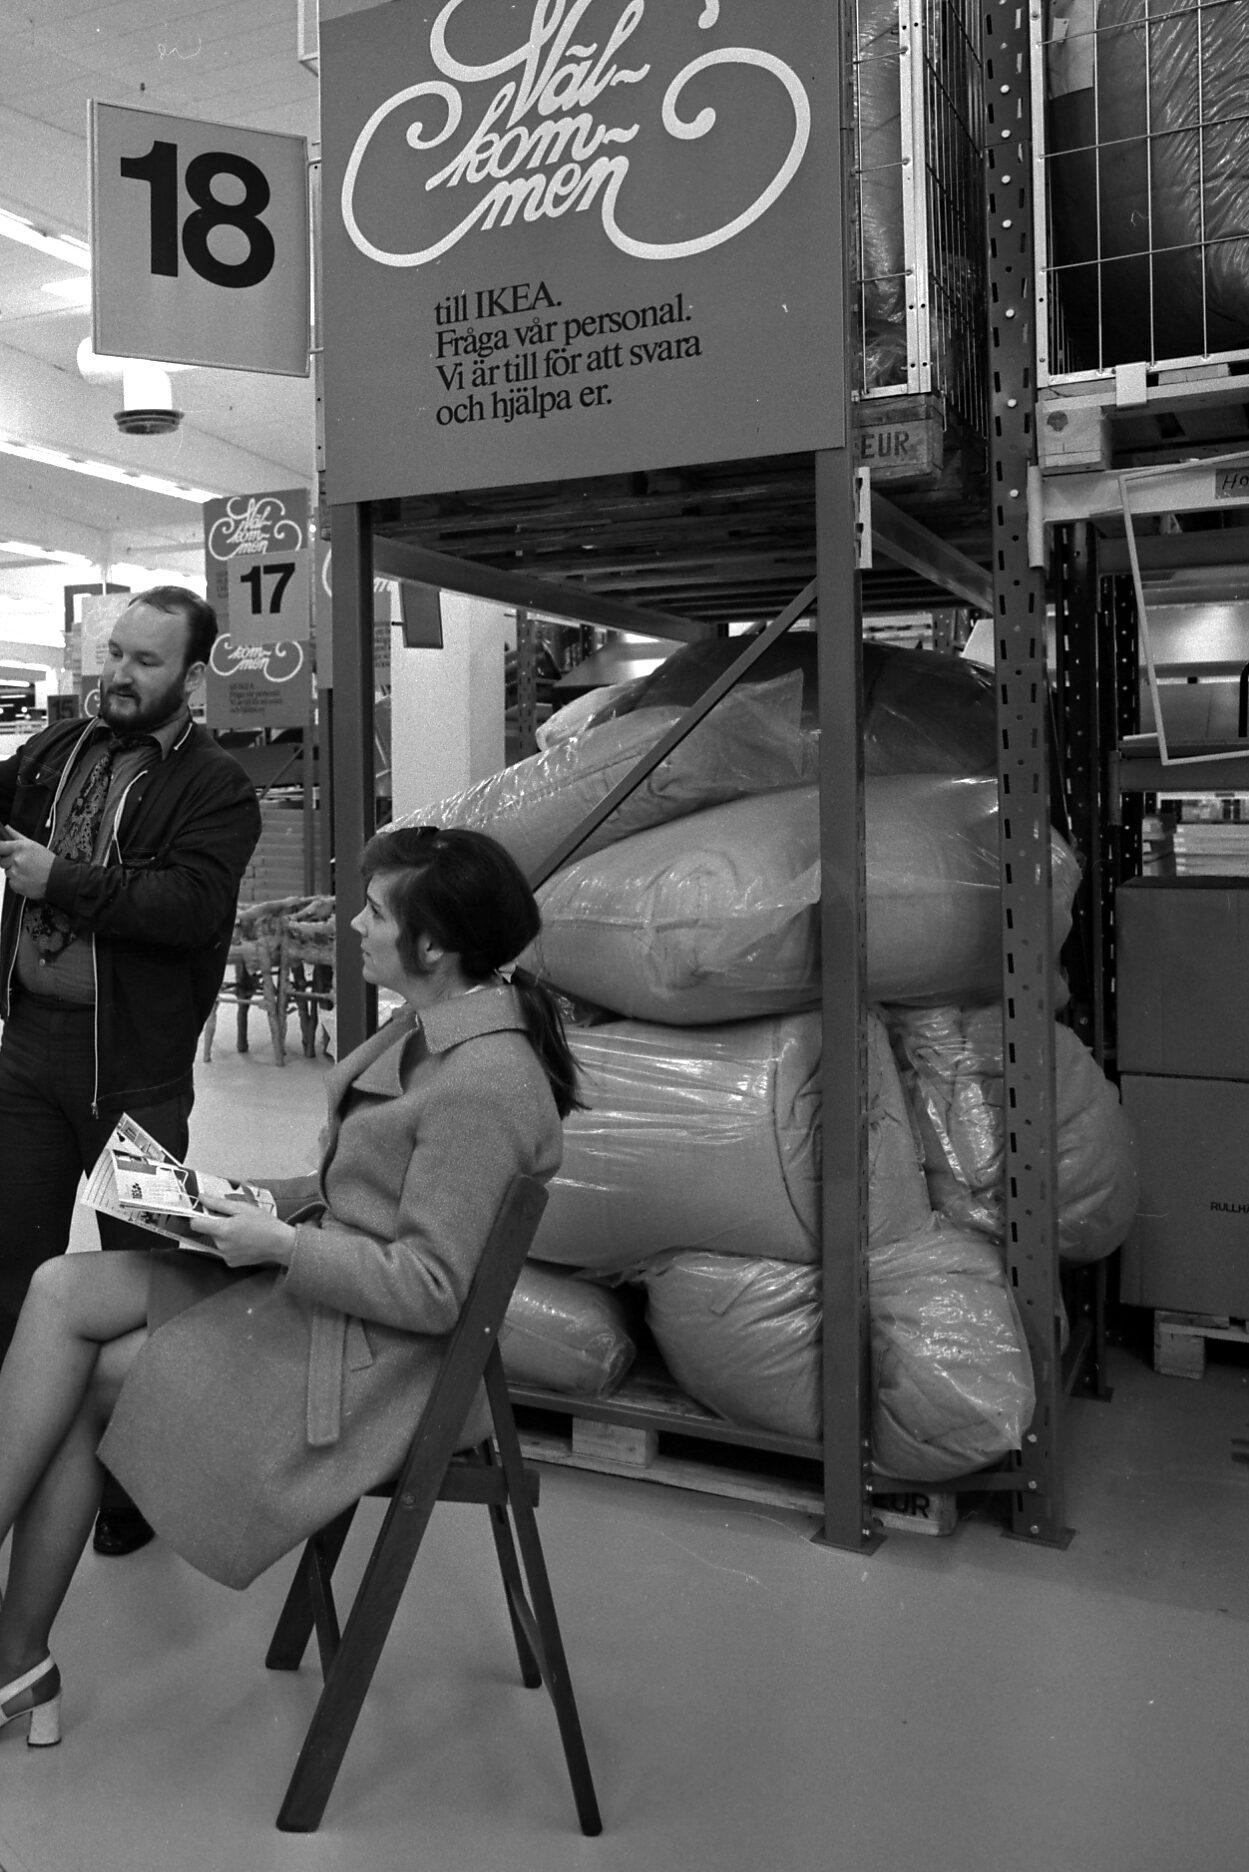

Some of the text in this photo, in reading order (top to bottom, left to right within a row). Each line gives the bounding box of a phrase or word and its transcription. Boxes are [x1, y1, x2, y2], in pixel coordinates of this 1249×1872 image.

[120, 140, 275, 288] 18
[434, 280, 562, 326] till IKEA.
[435, 293, 692, 359] Fråga vår personal.
[435, 334, 703, 391] Vi är till för att svara
[436, 384, 612, 426] och hjälpa er.
[861, 431, 910, 459] EUR
[240, 562, 296, 615] 17
